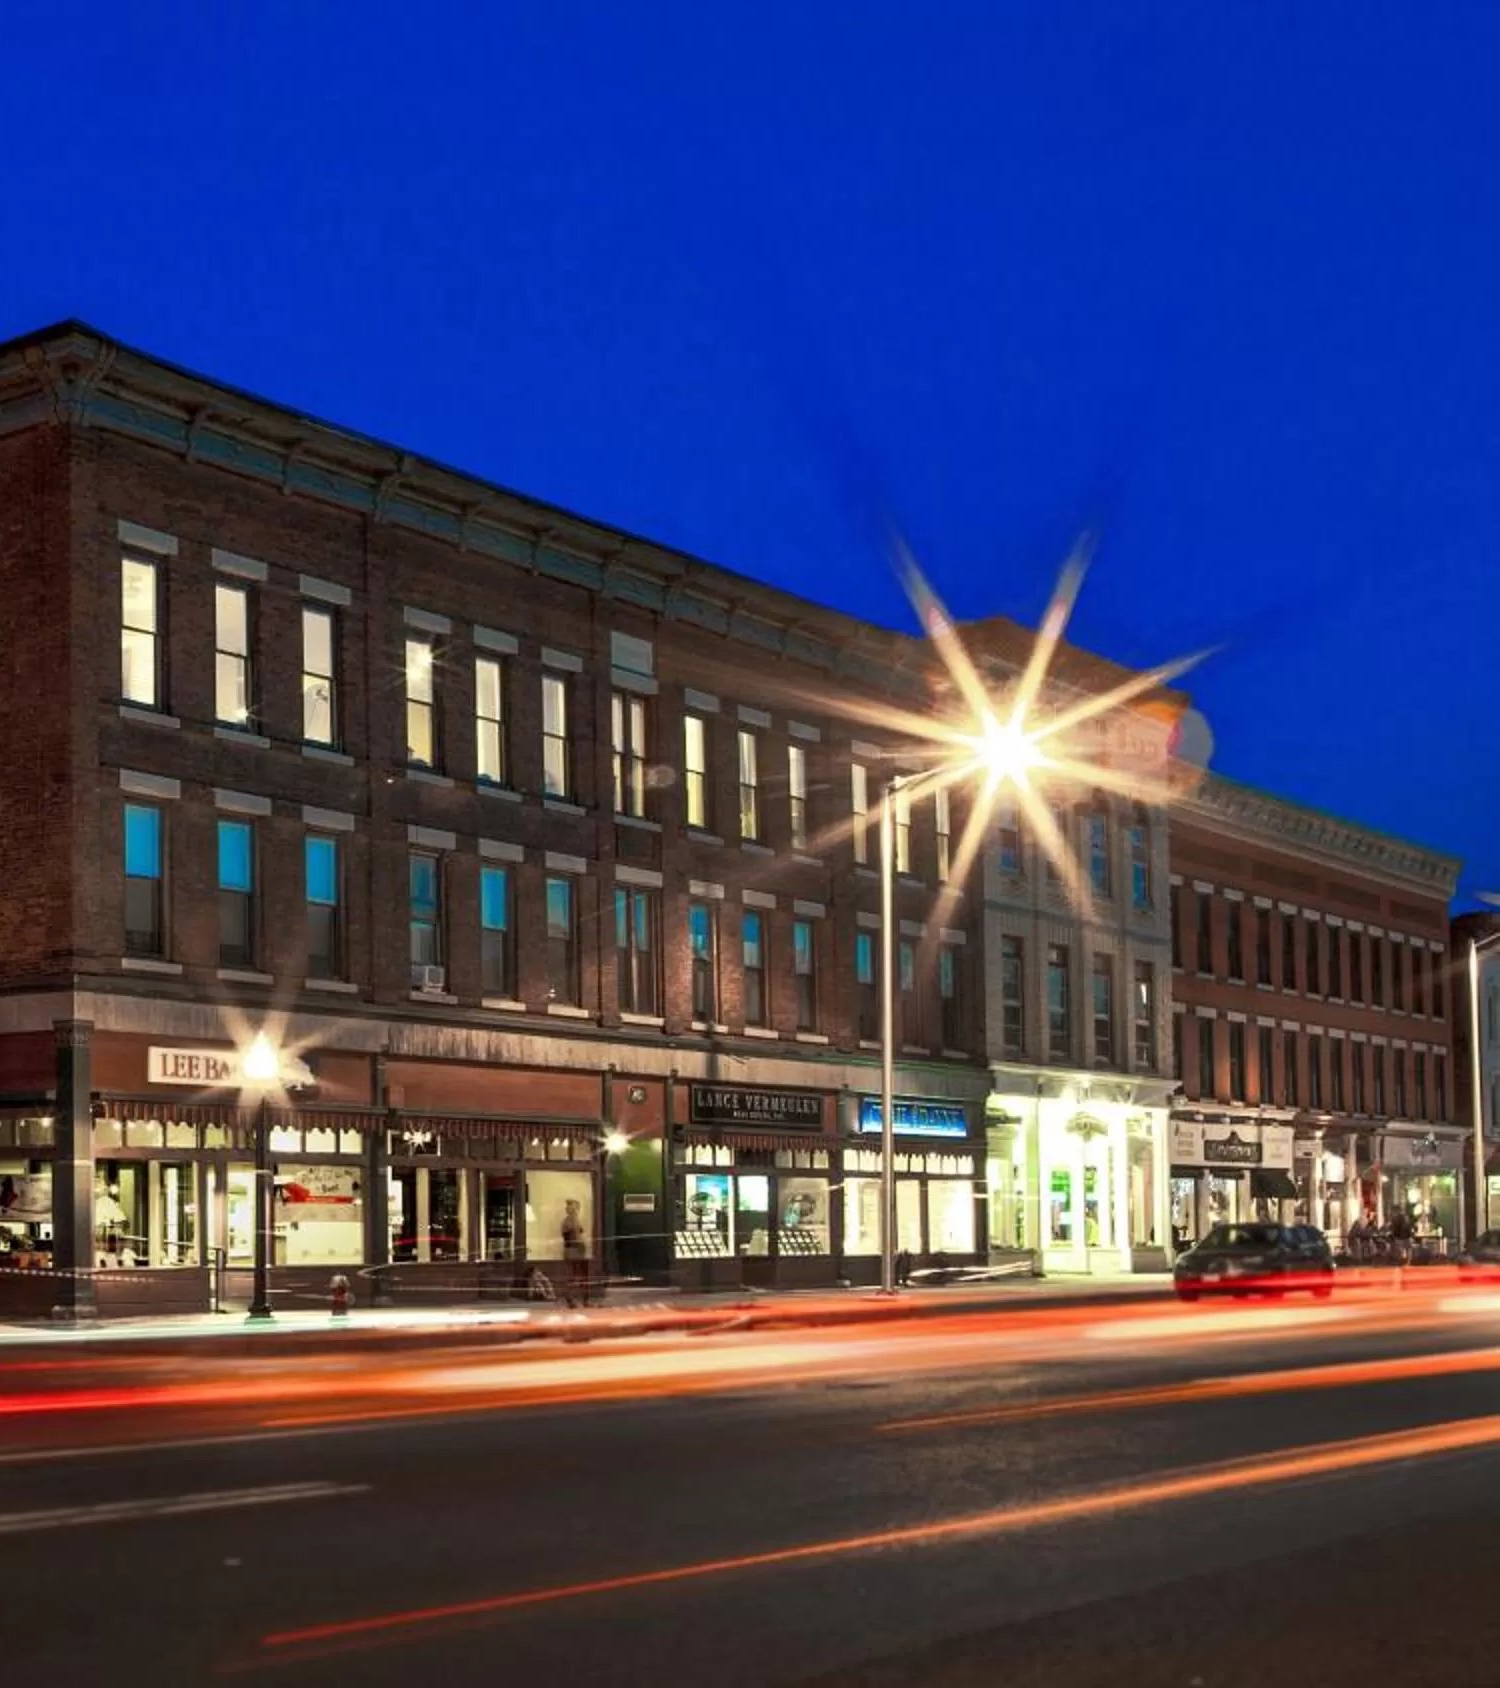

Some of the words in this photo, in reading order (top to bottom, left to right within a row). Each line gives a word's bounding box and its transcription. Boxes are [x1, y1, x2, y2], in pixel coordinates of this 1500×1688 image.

[161, 1053, 200, 1078] LEE
[204, 1056, 246, 1081] BA
[697, 1091, 740, 1109] LANCE
